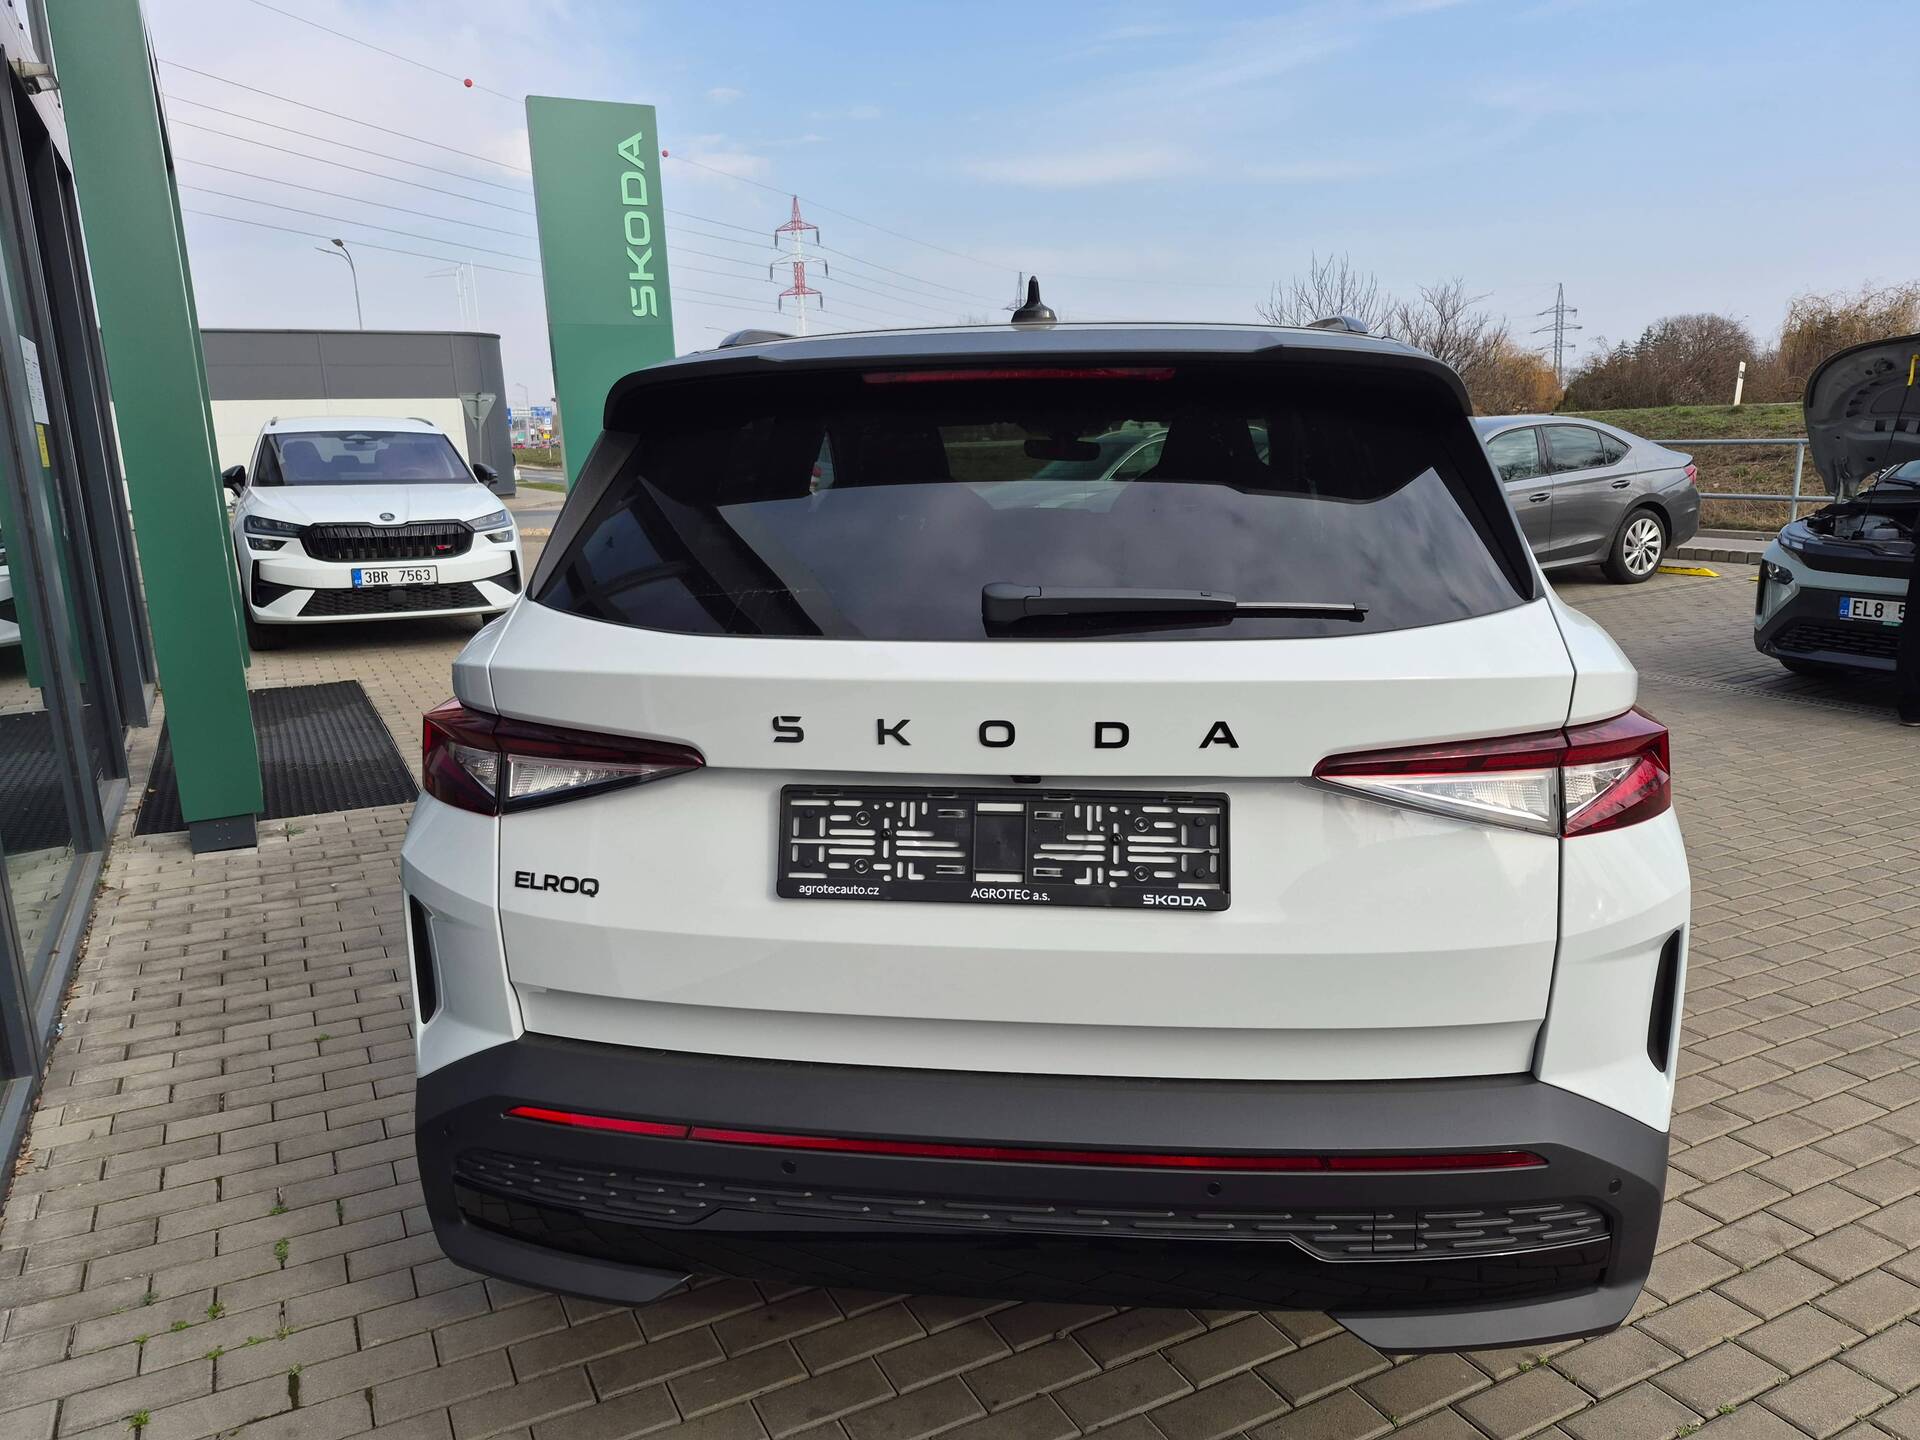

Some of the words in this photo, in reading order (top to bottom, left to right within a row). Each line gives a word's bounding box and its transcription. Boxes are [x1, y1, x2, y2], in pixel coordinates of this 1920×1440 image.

[364, 570, 389, 584] 3BR
[399, 569, 432, 583] 7563
[1852, 600, 1884, 618] EL8
[514, 870, 599, 898] ELROQ
[798, 884, 880, 895] agrotecauto.cz
[970, 888, 1030, 901] AGROTEC
[1032, 892, 1051, 901] a.s.
